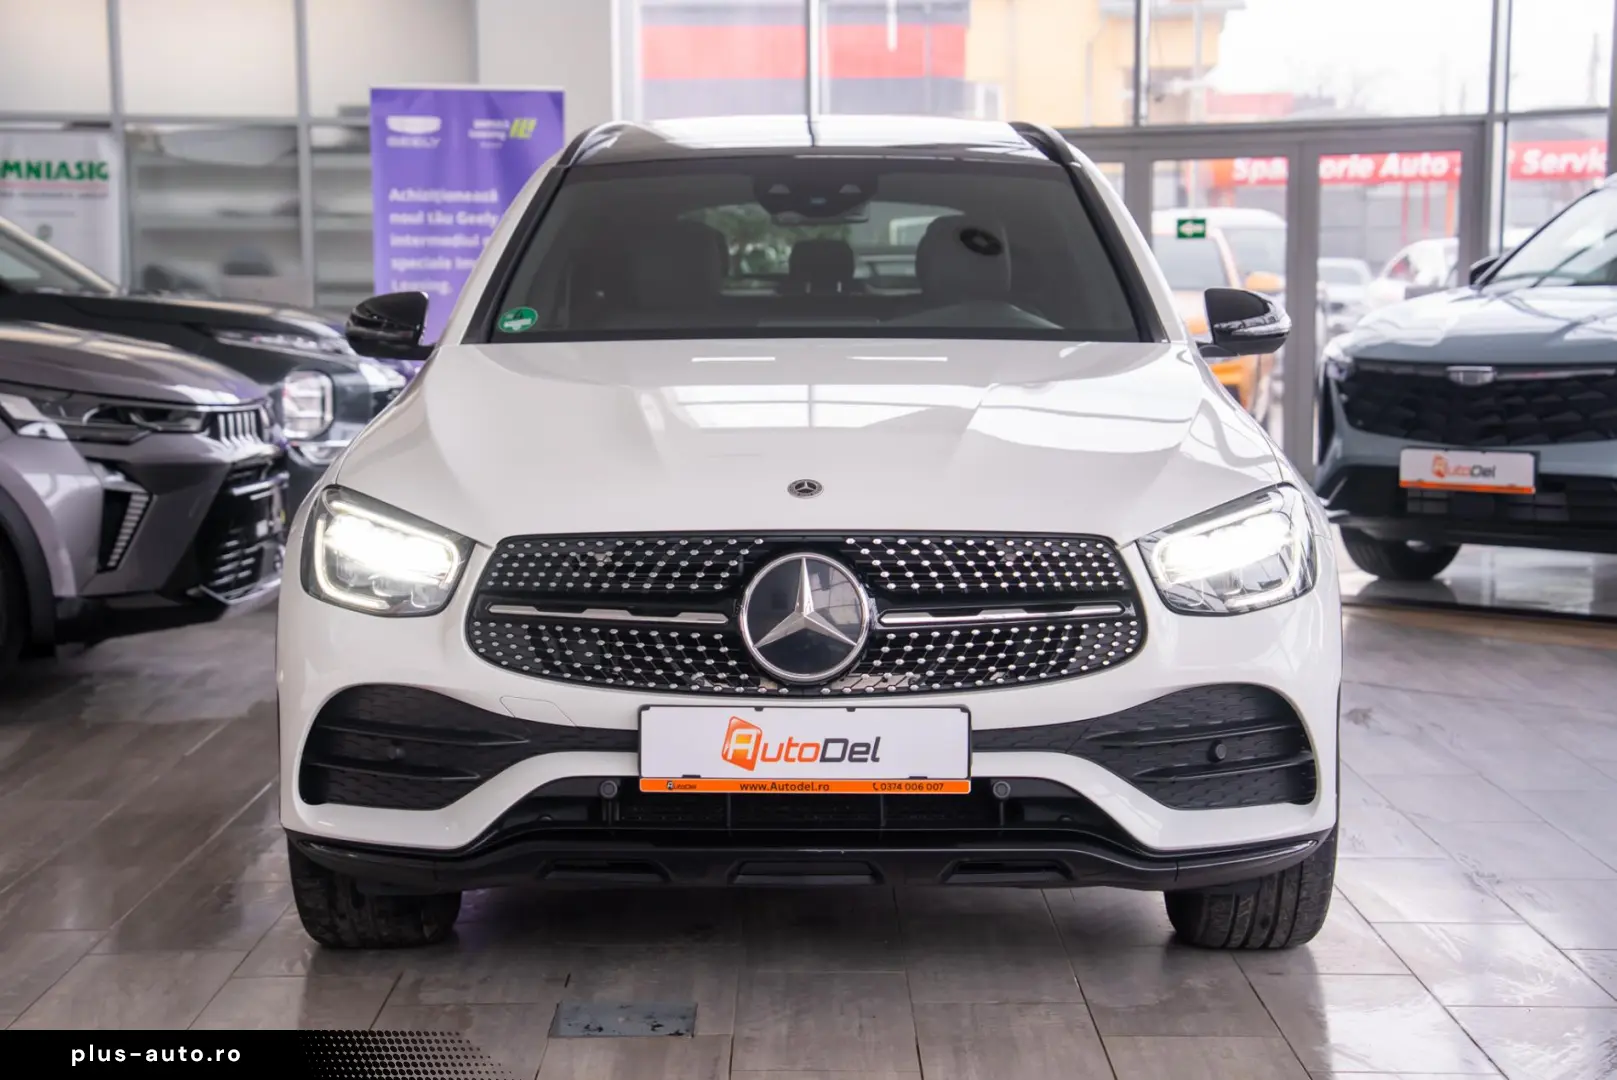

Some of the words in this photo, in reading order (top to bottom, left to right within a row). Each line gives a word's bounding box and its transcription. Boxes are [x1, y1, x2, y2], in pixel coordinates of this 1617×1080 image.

[0, 160, 109, 180] MNIASIG
[1379, 152, 1449, 178] Auto
[723, 722, 881, 766] AutoDel
[740, 781, 830, 792] www.Autodel.ro
[880, 782, 901, 791] 0374
[905, 782, 924, 791] 006
[926, 783, 944, 792] 007
